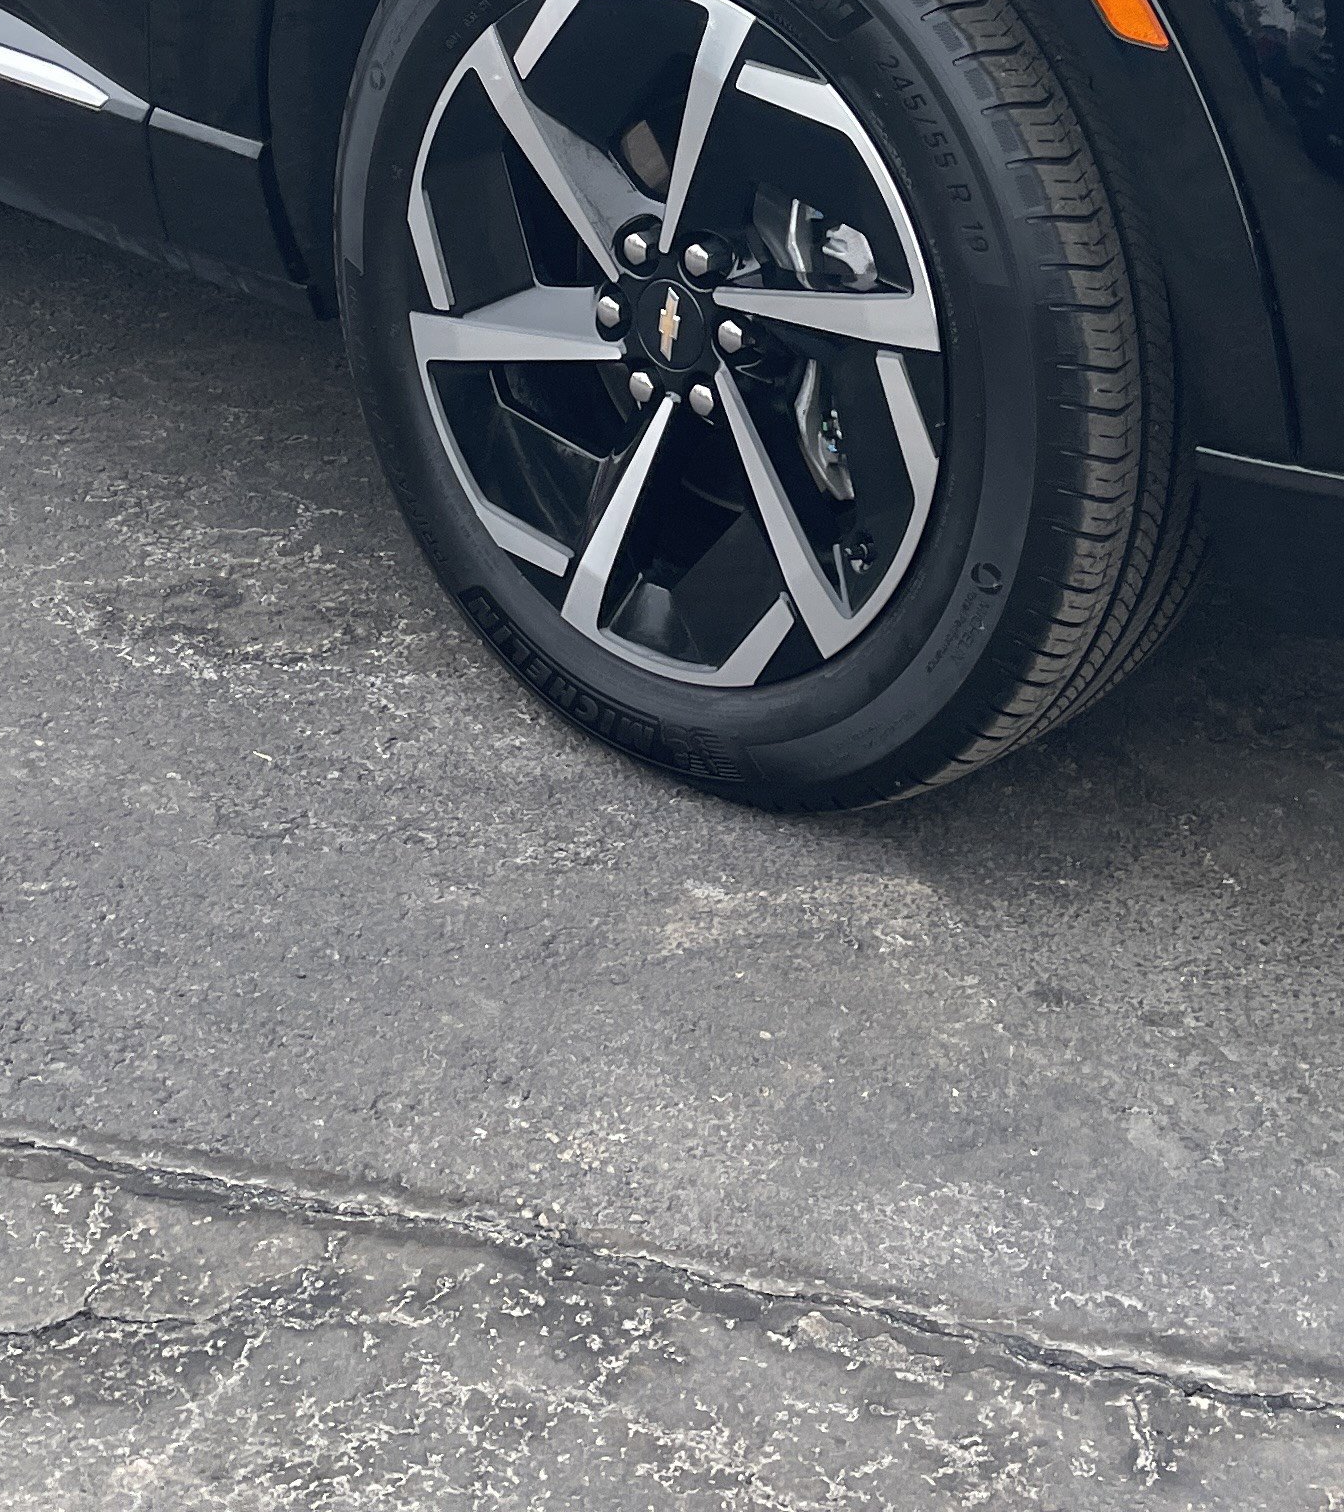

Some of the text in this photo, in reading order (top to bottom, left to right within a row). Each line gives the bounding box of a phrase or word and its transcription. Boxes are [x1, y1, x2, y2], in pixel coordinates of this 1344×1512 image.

[876, 54, 958, 169] 245/55
[947, 183, 972, 202] R
[467, 596, 655, 752] MICHELIN
